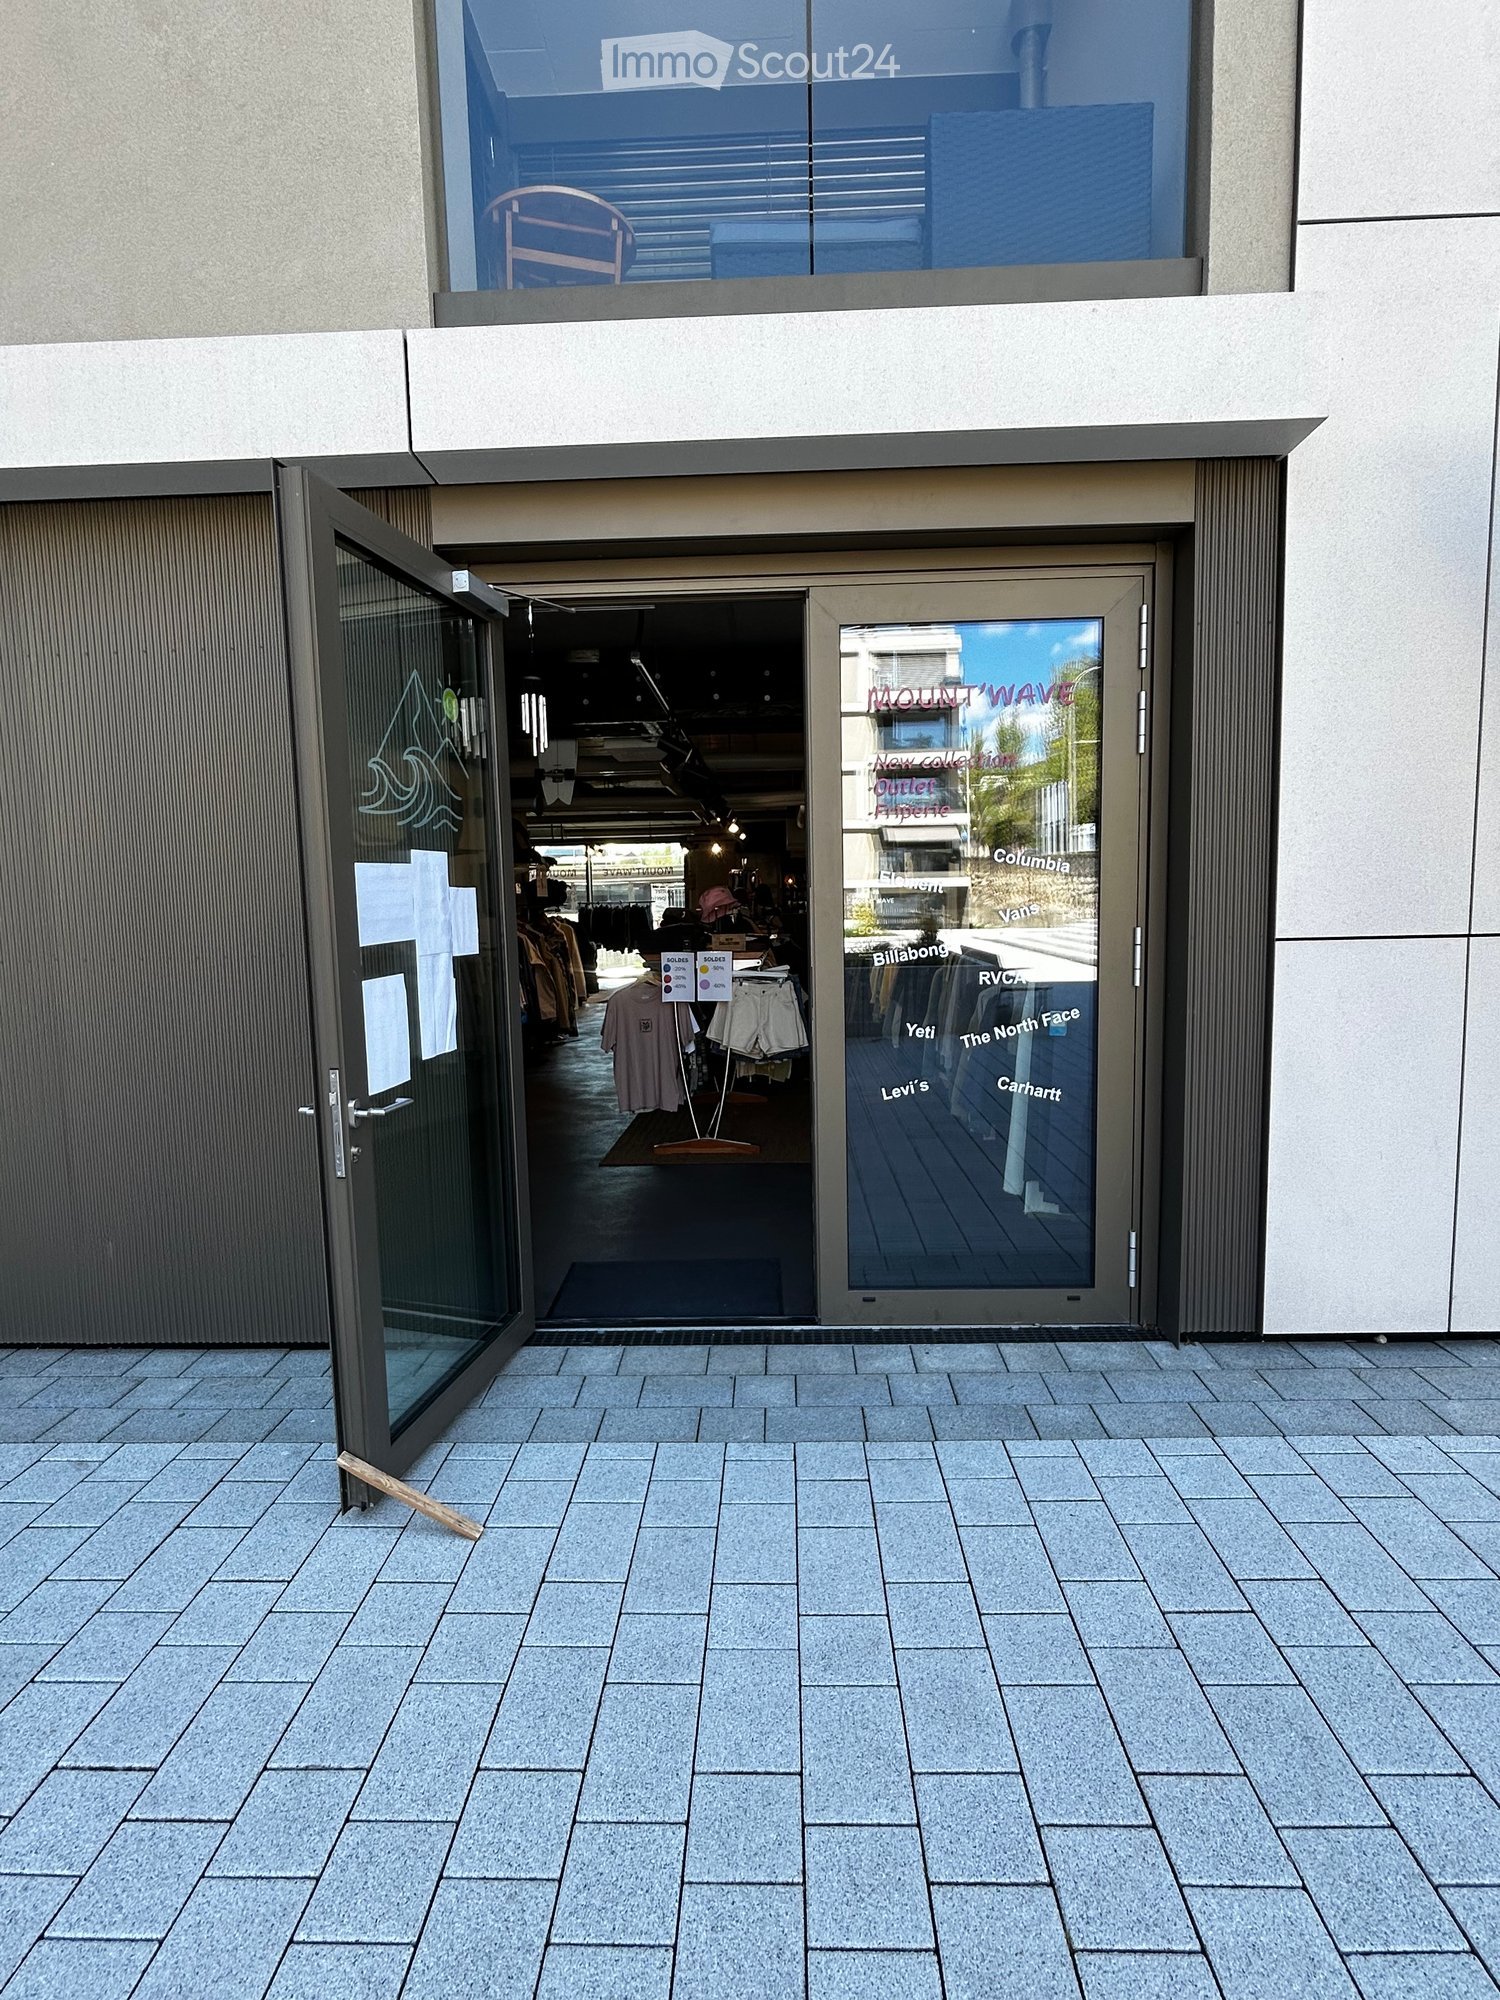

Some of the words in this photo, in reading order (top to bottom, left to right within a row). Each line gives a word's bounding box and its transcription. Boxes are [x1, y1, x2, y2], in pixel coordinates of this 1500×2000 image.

[867, 681, 1077, 714] MOUNT'WAVE
[873, 752, 916, 773] New
[920, 750, 1018, 770] collection
[873, 777, 937, 797] Outlet
[873, 802, 952, 825] Friperie
[993, 848, 1072, 875] Columbia
[878, 869, 945, 894] Element
[998, 903, 1041, 924] Vans
[872, 942, 951, 967] Billabong
[978, 970, 1027, 986] RVCA
[905, 1022, 937, 1040] Yeti
[959, 1032, 991, 1049] The
[993, 1017, 1039, 1041] North
[1041, 1007, 1081, 1028] Face
[996, 1075, 1062, 1102] Carhartt
